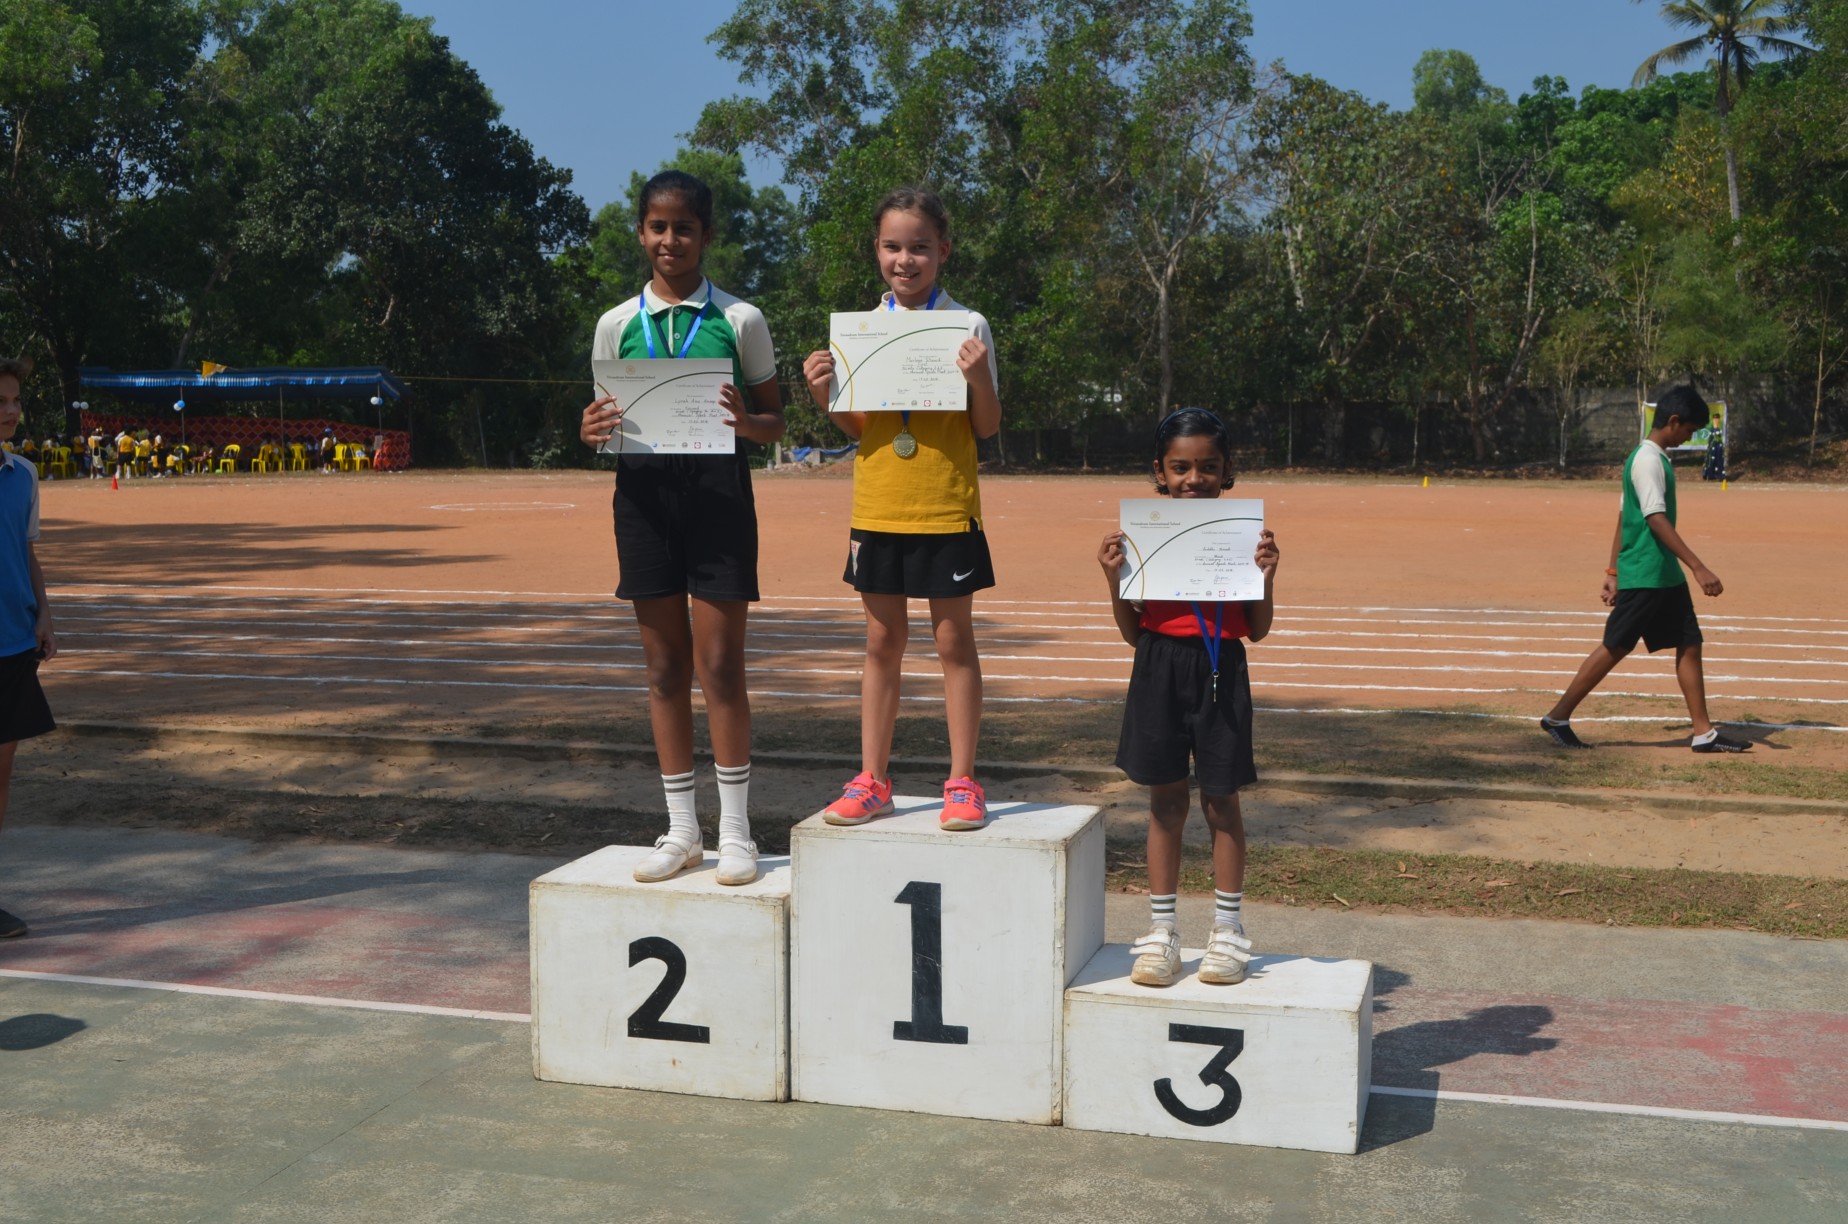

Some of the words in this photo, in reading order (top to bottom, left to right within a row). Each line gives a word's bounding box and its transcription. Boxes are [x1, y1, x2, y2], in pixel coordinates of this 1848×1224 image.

[627, 936, 710, 1043] 2
[892, 880, 968, 1044] 1
[1153, 1022, 1244, 1126] 3
